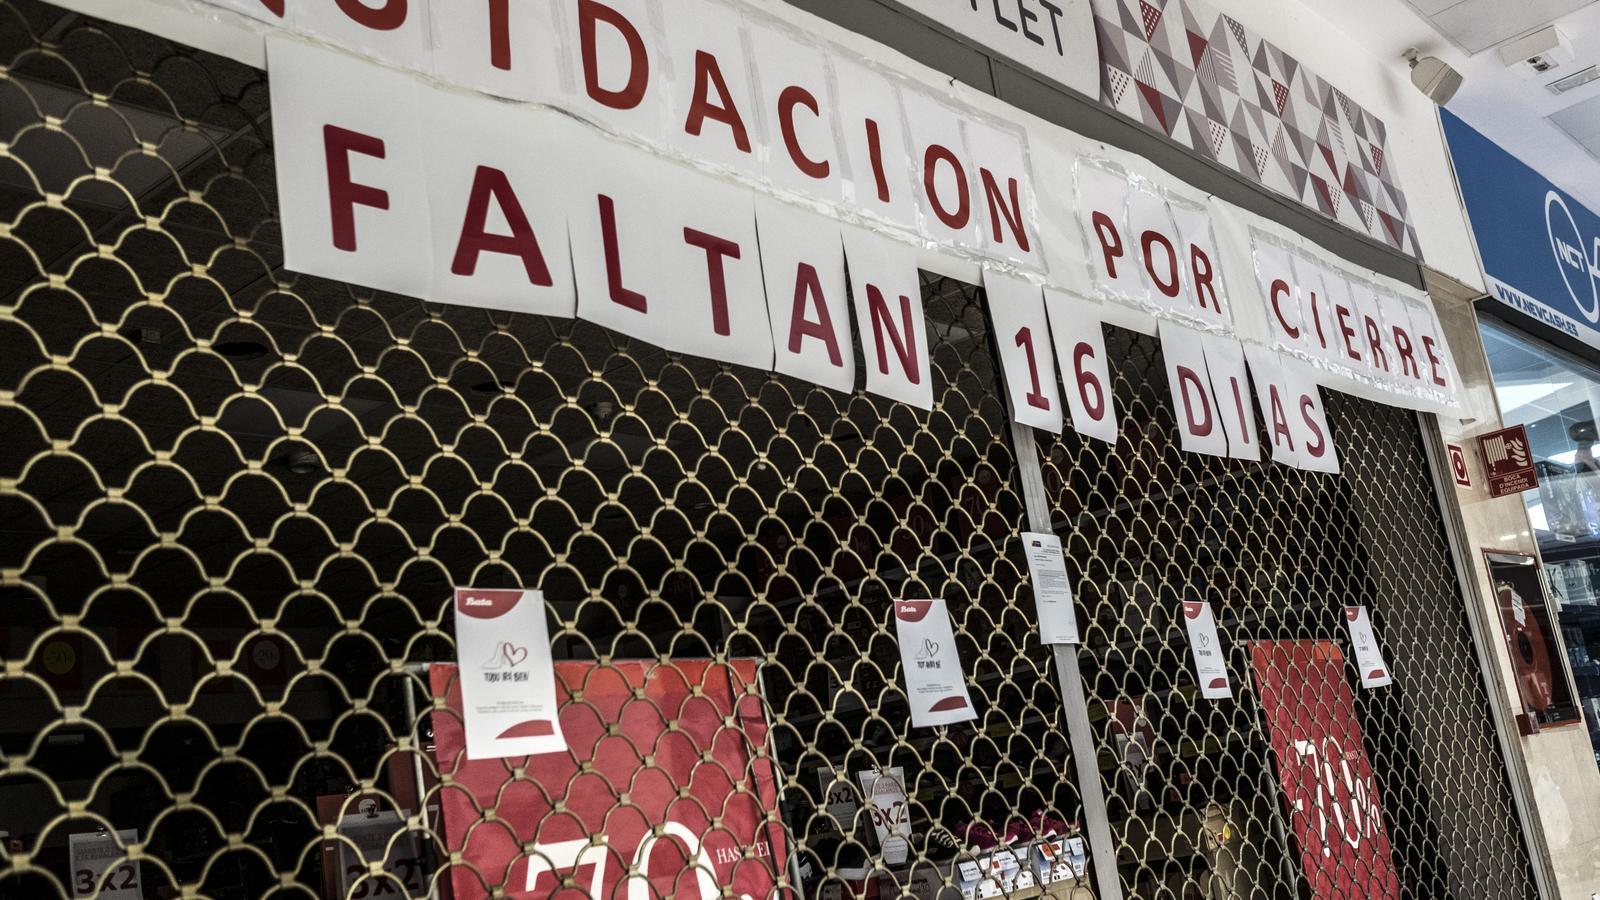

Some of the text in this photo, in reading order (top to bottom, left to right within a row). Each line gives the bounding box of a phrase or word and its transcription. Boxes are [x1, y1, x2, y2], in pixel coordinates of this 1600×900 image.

[969, 0, 1064, 57] LET
[1555, 236, 1585, 273] NCT
[323, 123, 1326, 458] FALTAN 16 DIAS
[1092, 210, 1222, 315] POR
[1270, 278, 1448, 388] CIERRE
[1503, 474, 1521, 482] BOCA
[76, 865, 138, 894] 3x2
